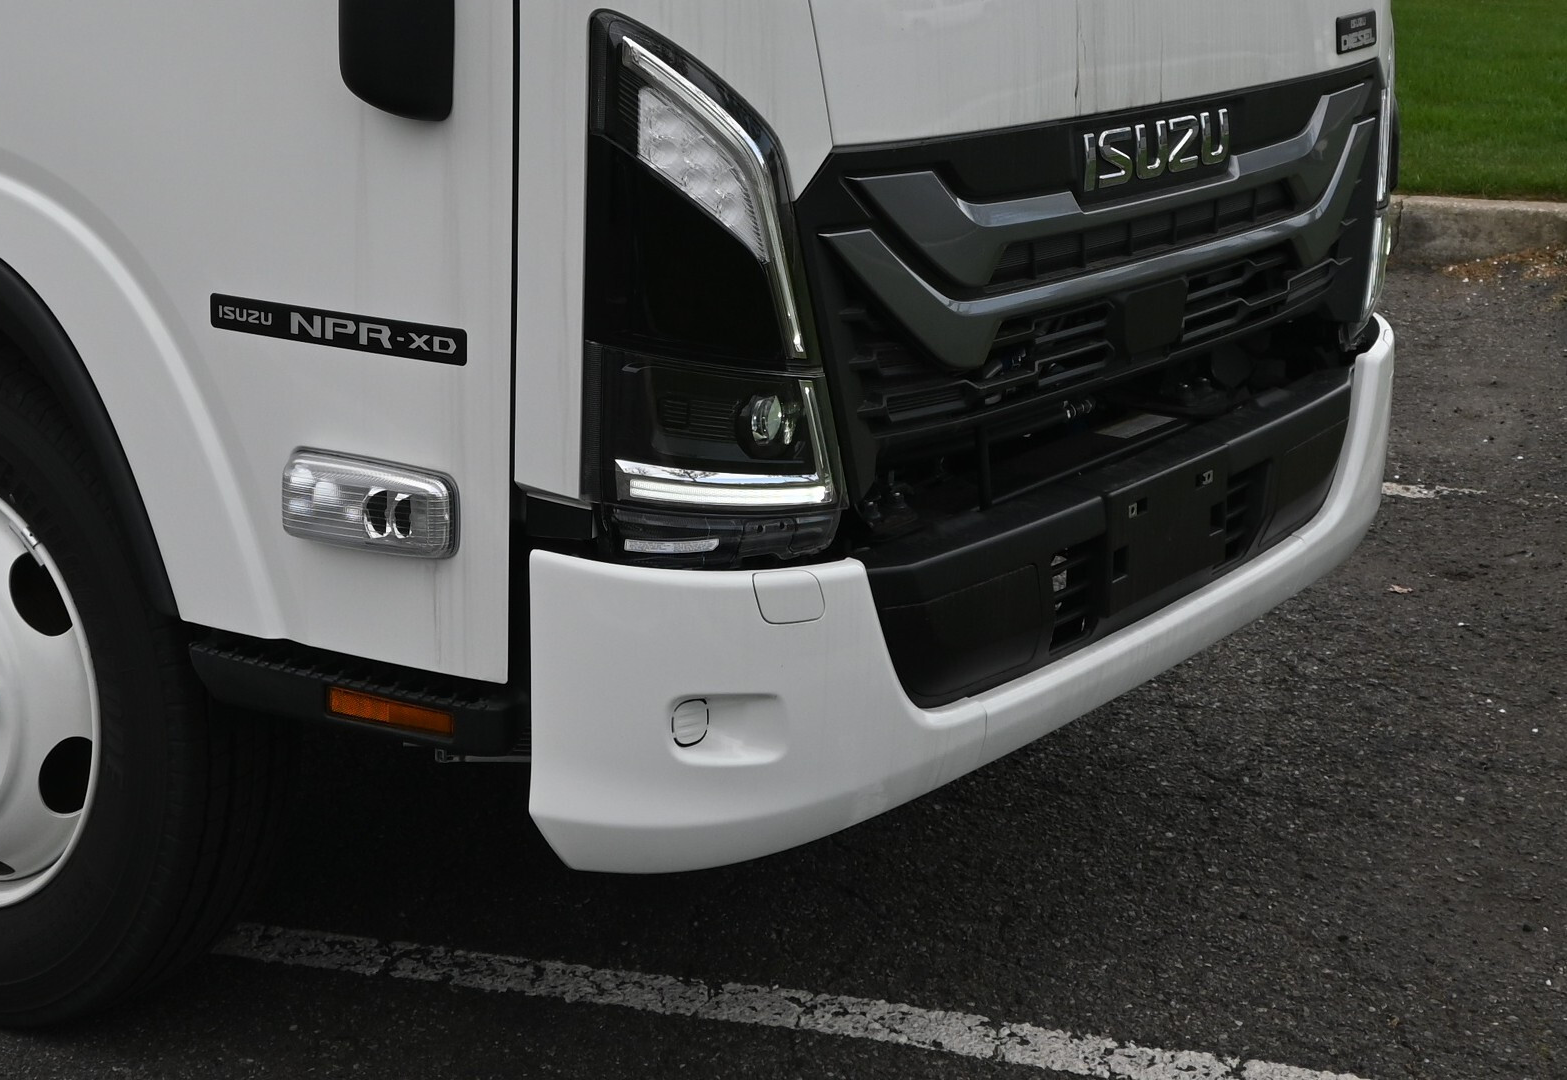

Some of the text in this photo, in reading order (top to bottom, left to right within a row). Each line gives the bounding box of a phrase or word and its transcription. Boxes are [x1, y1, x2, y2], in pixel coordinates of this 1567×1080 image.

[1341, 28, 1375, 51] DIESEL
[1083, 108, 1230, 192] ISUZU
[219, 305, 456, 354] ISUZU NPR-XD
